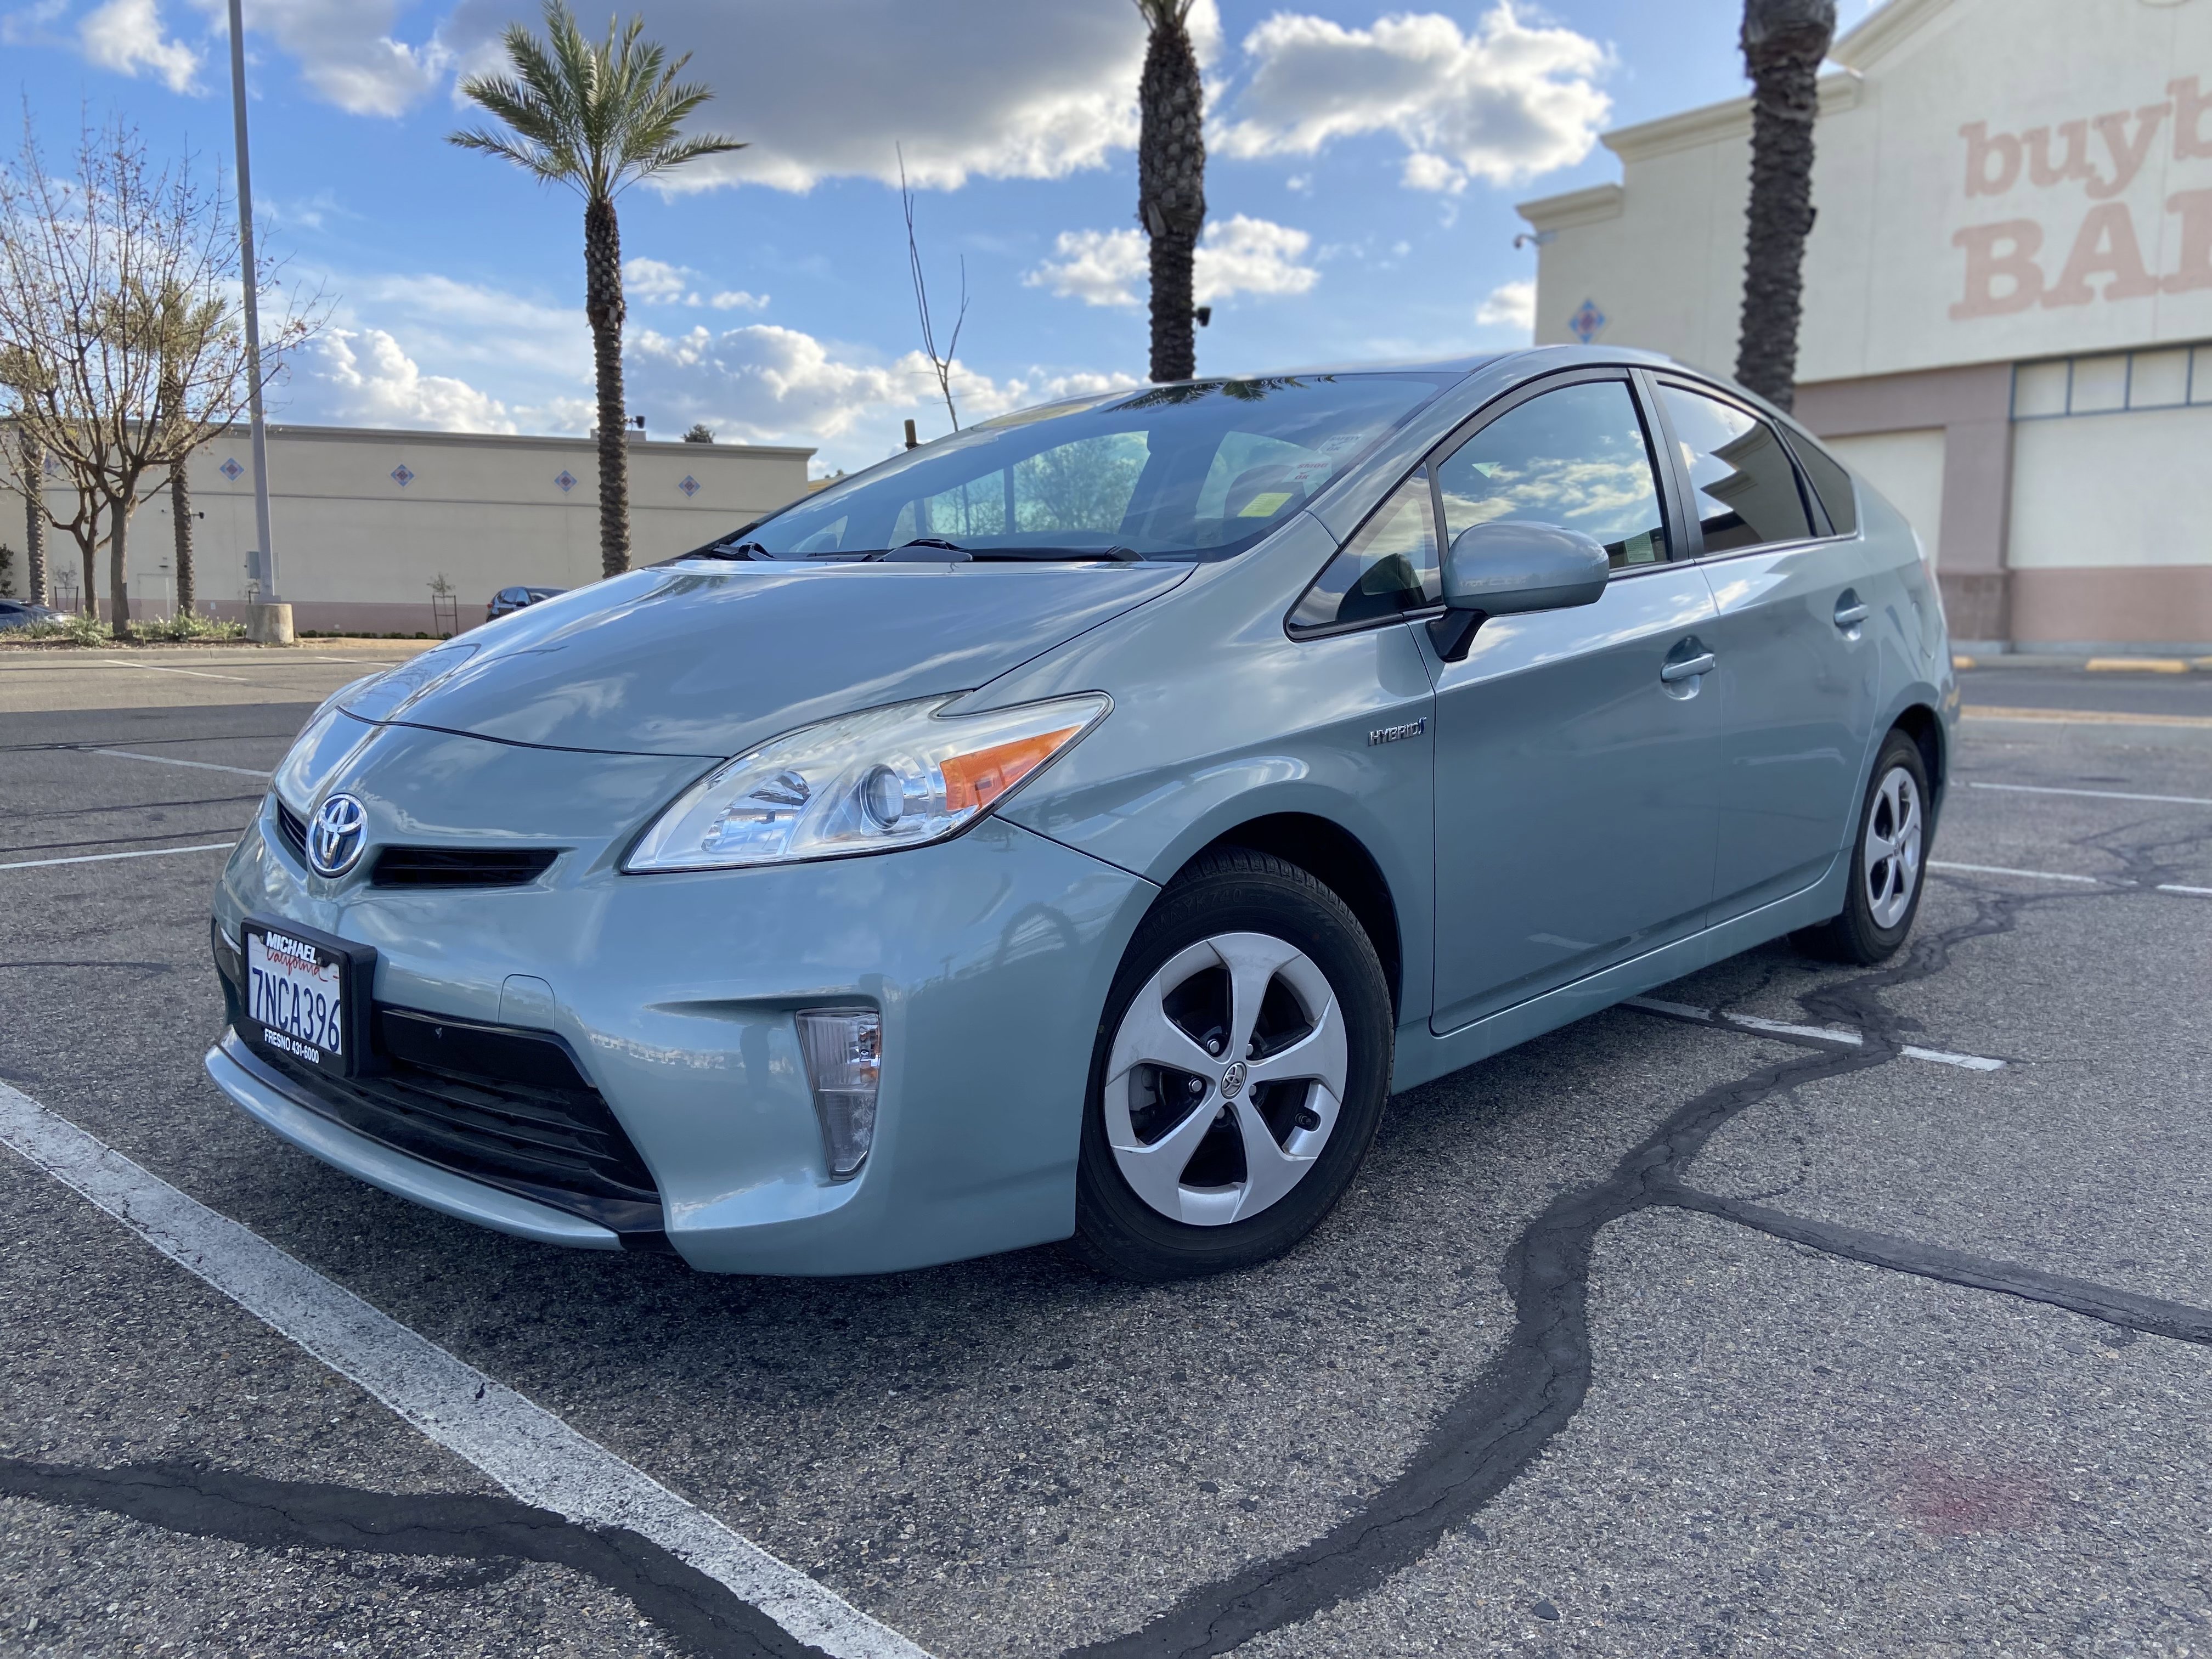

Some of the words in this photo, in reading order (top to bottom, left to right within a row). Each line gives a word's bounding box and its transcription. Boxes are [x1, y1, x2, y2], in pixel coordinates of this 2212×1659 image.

[1369, 722, 1419, 747] HYBRID
[266, 931, 317, 964] MICHAEL
[252, 967, 340, 1052] 7NCA396
[264, 1028, 291, 1052] FRESNO
[291, 1040, 319, 1064] 431-6000
